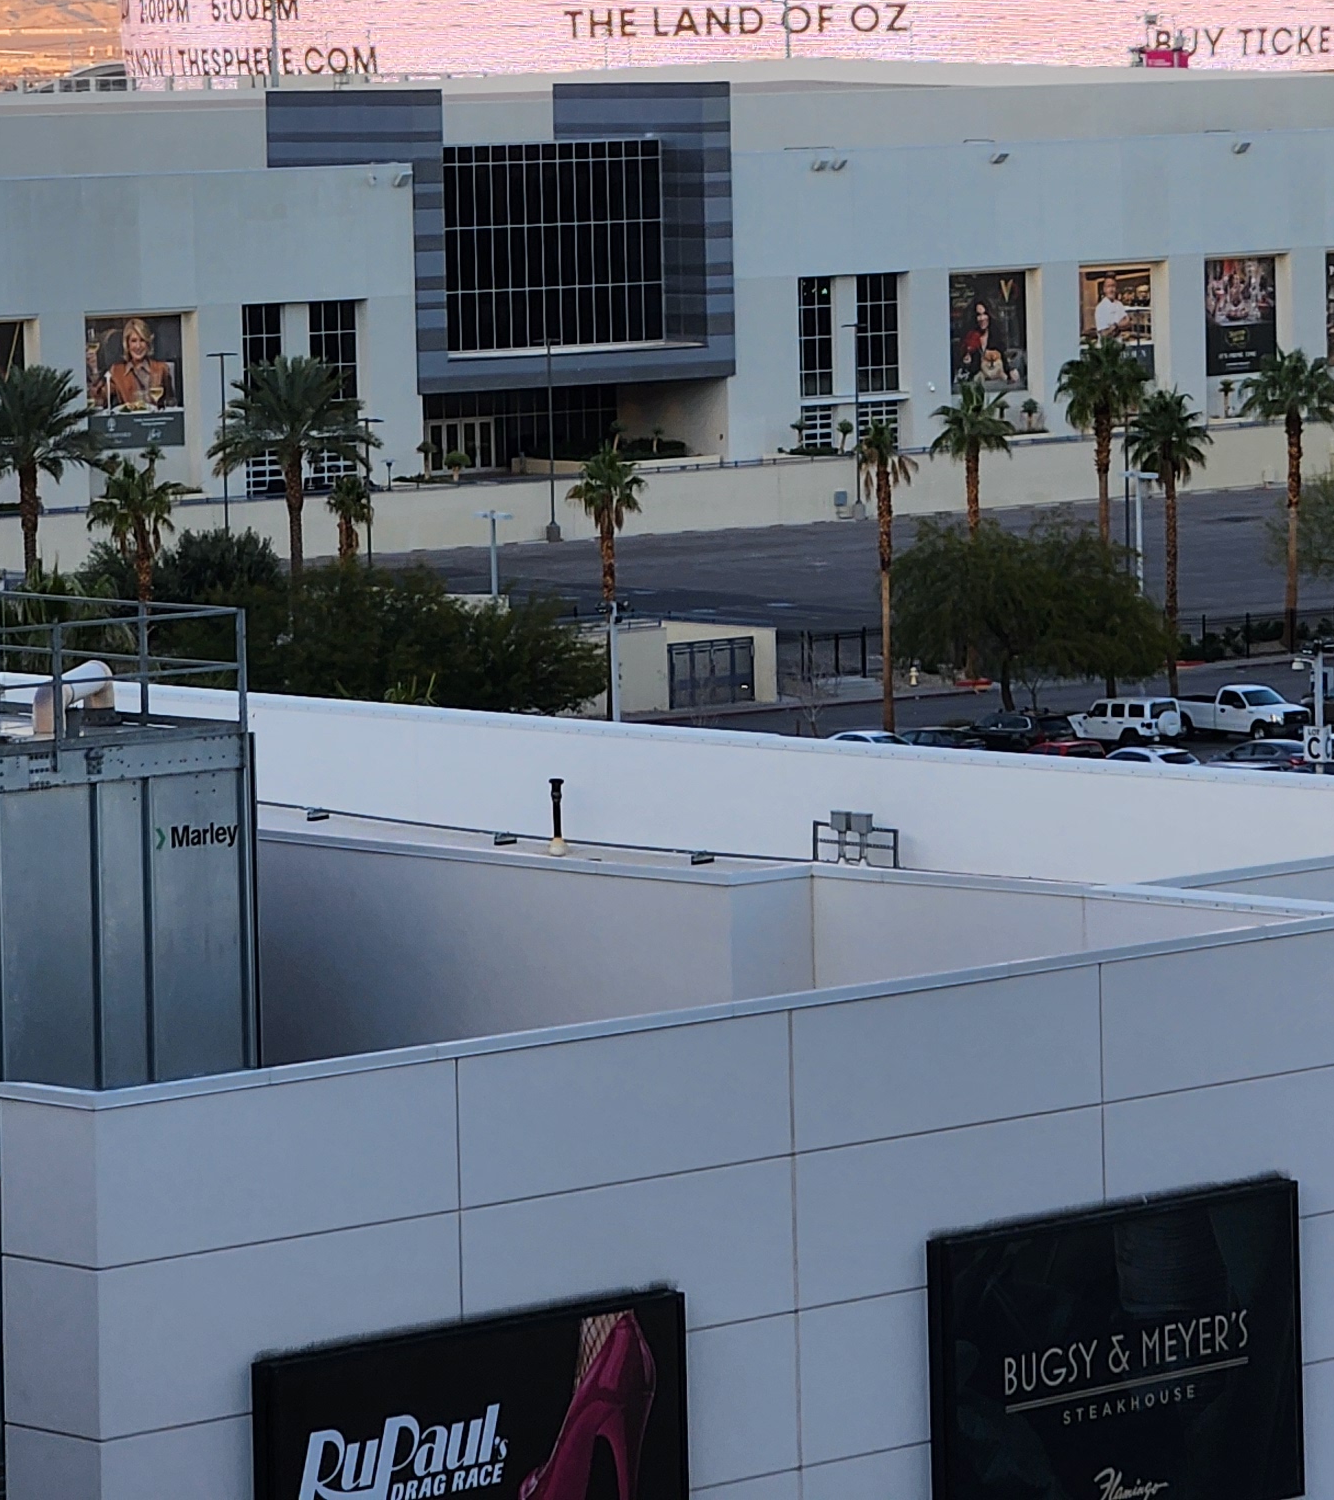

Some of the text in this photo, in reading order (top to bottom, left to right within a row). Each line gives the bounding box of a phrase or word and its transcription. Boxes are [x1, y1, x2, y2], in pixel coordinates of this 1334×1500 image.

[564, 2, 912, 39] THE LAND OF OZ
[178, 44, 379, 77] THESPHEE.COM
[1307, 728, 1321, 736] LOT
[1307, 736, 1321, 760] C
[170, 821, 240, 850] Marley
[1004, 1308, 1249, 1396] BUGSY & MEYER'S
[1062, 1383, 1197, 1426] STEAKHOUSE
[298, 1403, 509, 1500] RuPaul's
[391, 1462, 505, 1500] DRAG RACE
[1093, 1466, 1170, 1500] Flamingo
